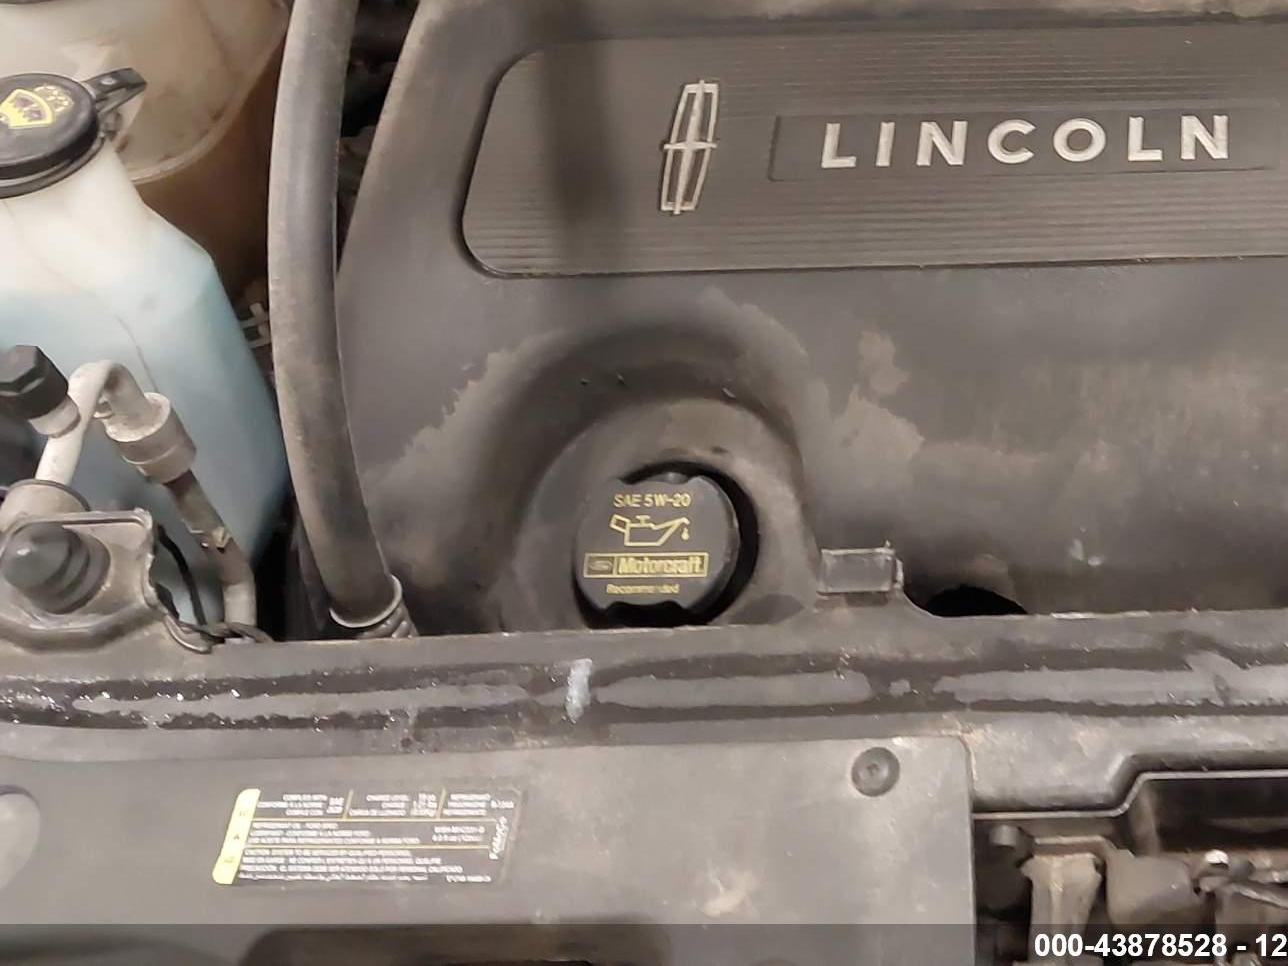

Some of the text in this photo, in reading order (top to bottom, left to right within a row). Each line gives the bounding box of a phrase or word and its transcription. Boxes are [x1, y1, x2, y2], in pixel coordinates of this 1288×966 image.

[821, 114, 1230, 169] LINCOLN
[613, 493, 692, 508] SAE 5W-20
[618, 556, 702, 575] Motorcraft
[606, 583, 680, 595] Recommeded
